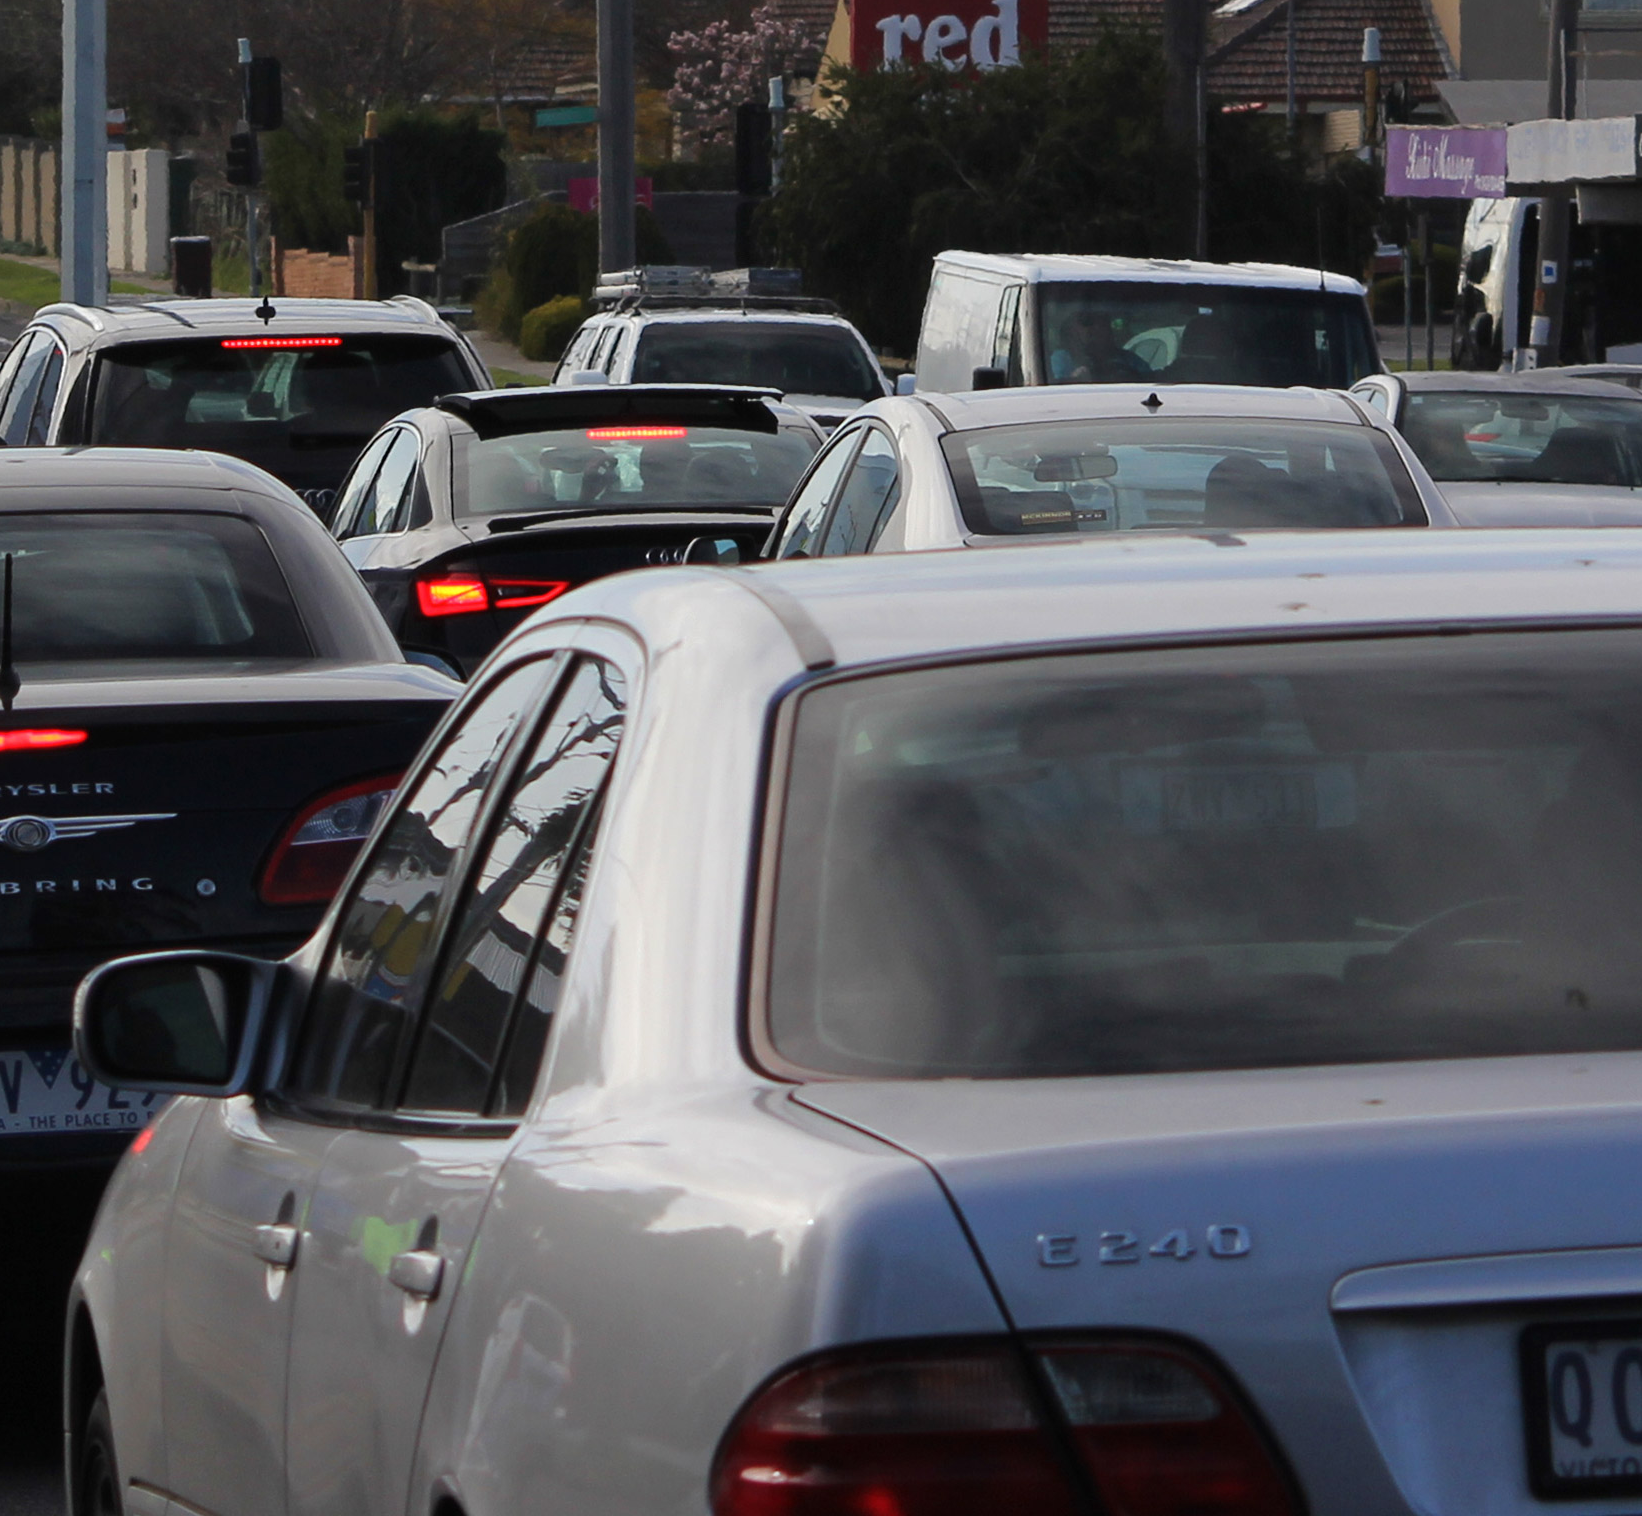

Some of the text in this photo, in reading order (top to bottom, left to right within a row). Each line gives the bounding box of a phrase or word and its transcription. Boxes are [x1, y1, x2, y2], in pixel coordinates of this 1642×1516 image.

[29, 1116, 56, 1129] THE
[65, 1113, 110, 1127] PLACE
[119, 1112, 138, 1124] TO
[1037, 1224, 1252, 1268] E 240
